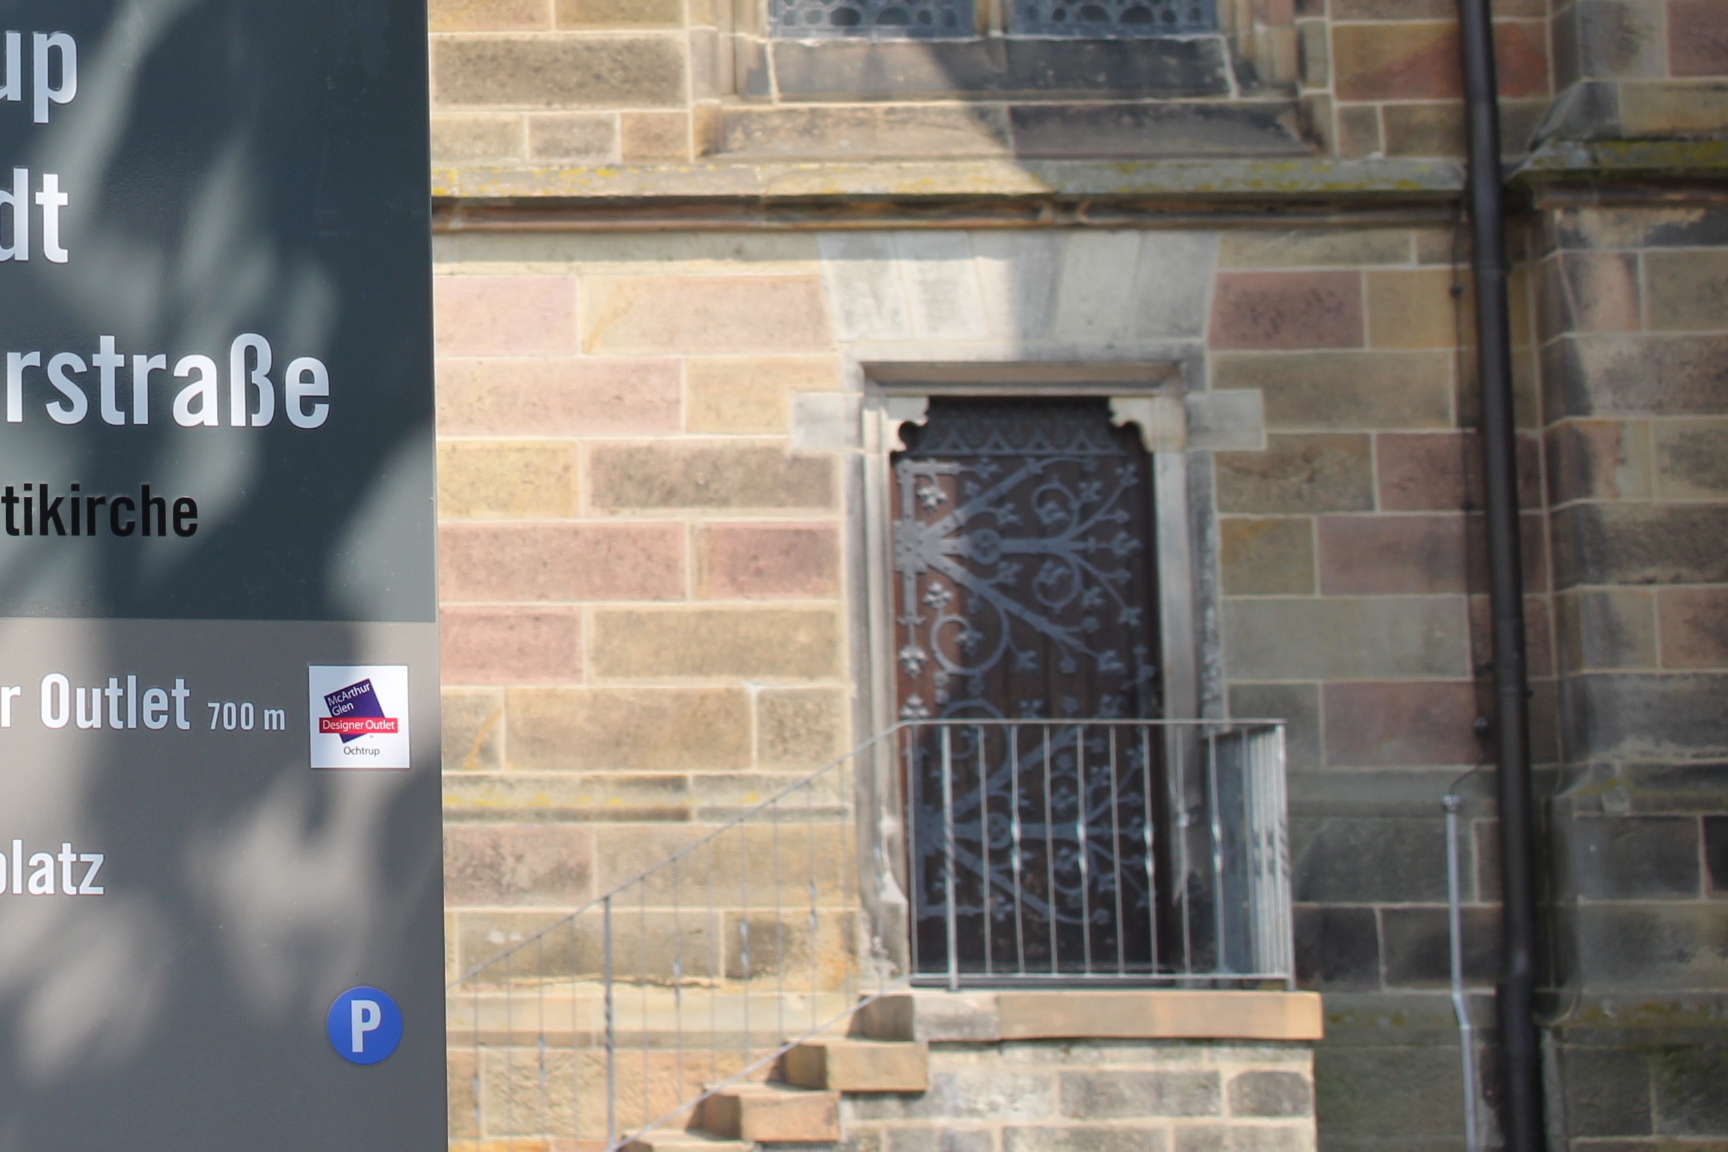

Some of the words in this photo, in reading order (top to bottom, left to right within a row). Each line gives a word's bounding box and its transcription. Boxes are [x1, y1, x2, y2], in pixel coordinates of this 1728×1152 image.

[39, 673, 191, 731] Outlet
[207, 701, 257, 731] 700
[263, 710, 286, 731] m
[327, 683, 370, 706] McArthur
[332, 702, 354, 716] Glen
[322, 720, 364, 732] Designer
[365, 720, 395, 730] Outlet
[343, 746, 380, 756] Ochtrup
[350, 1000, 381, 1052] P
